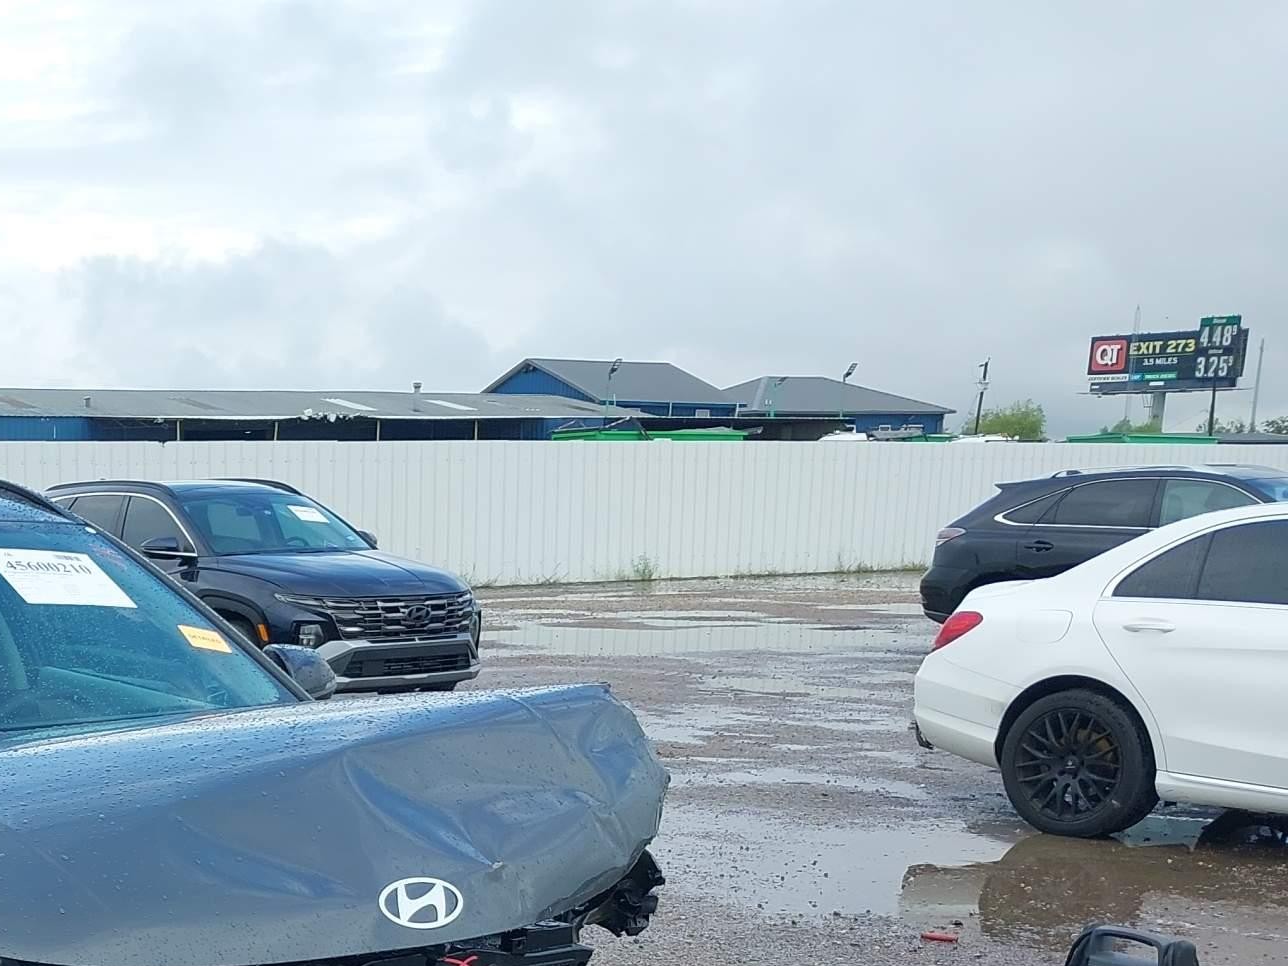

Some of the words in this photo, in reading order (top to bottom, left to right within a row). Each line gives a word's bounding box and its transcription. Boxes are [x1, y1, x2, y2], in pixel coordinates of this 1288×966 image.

[1129, 341, 1163, 355] EXIT
[1166, 339, 1196, 353] 273
[1096, 344, 1121, 366] QT
[1155, 357, 1178, 365] MILES
[6, 560, 92, 575] 45600210
